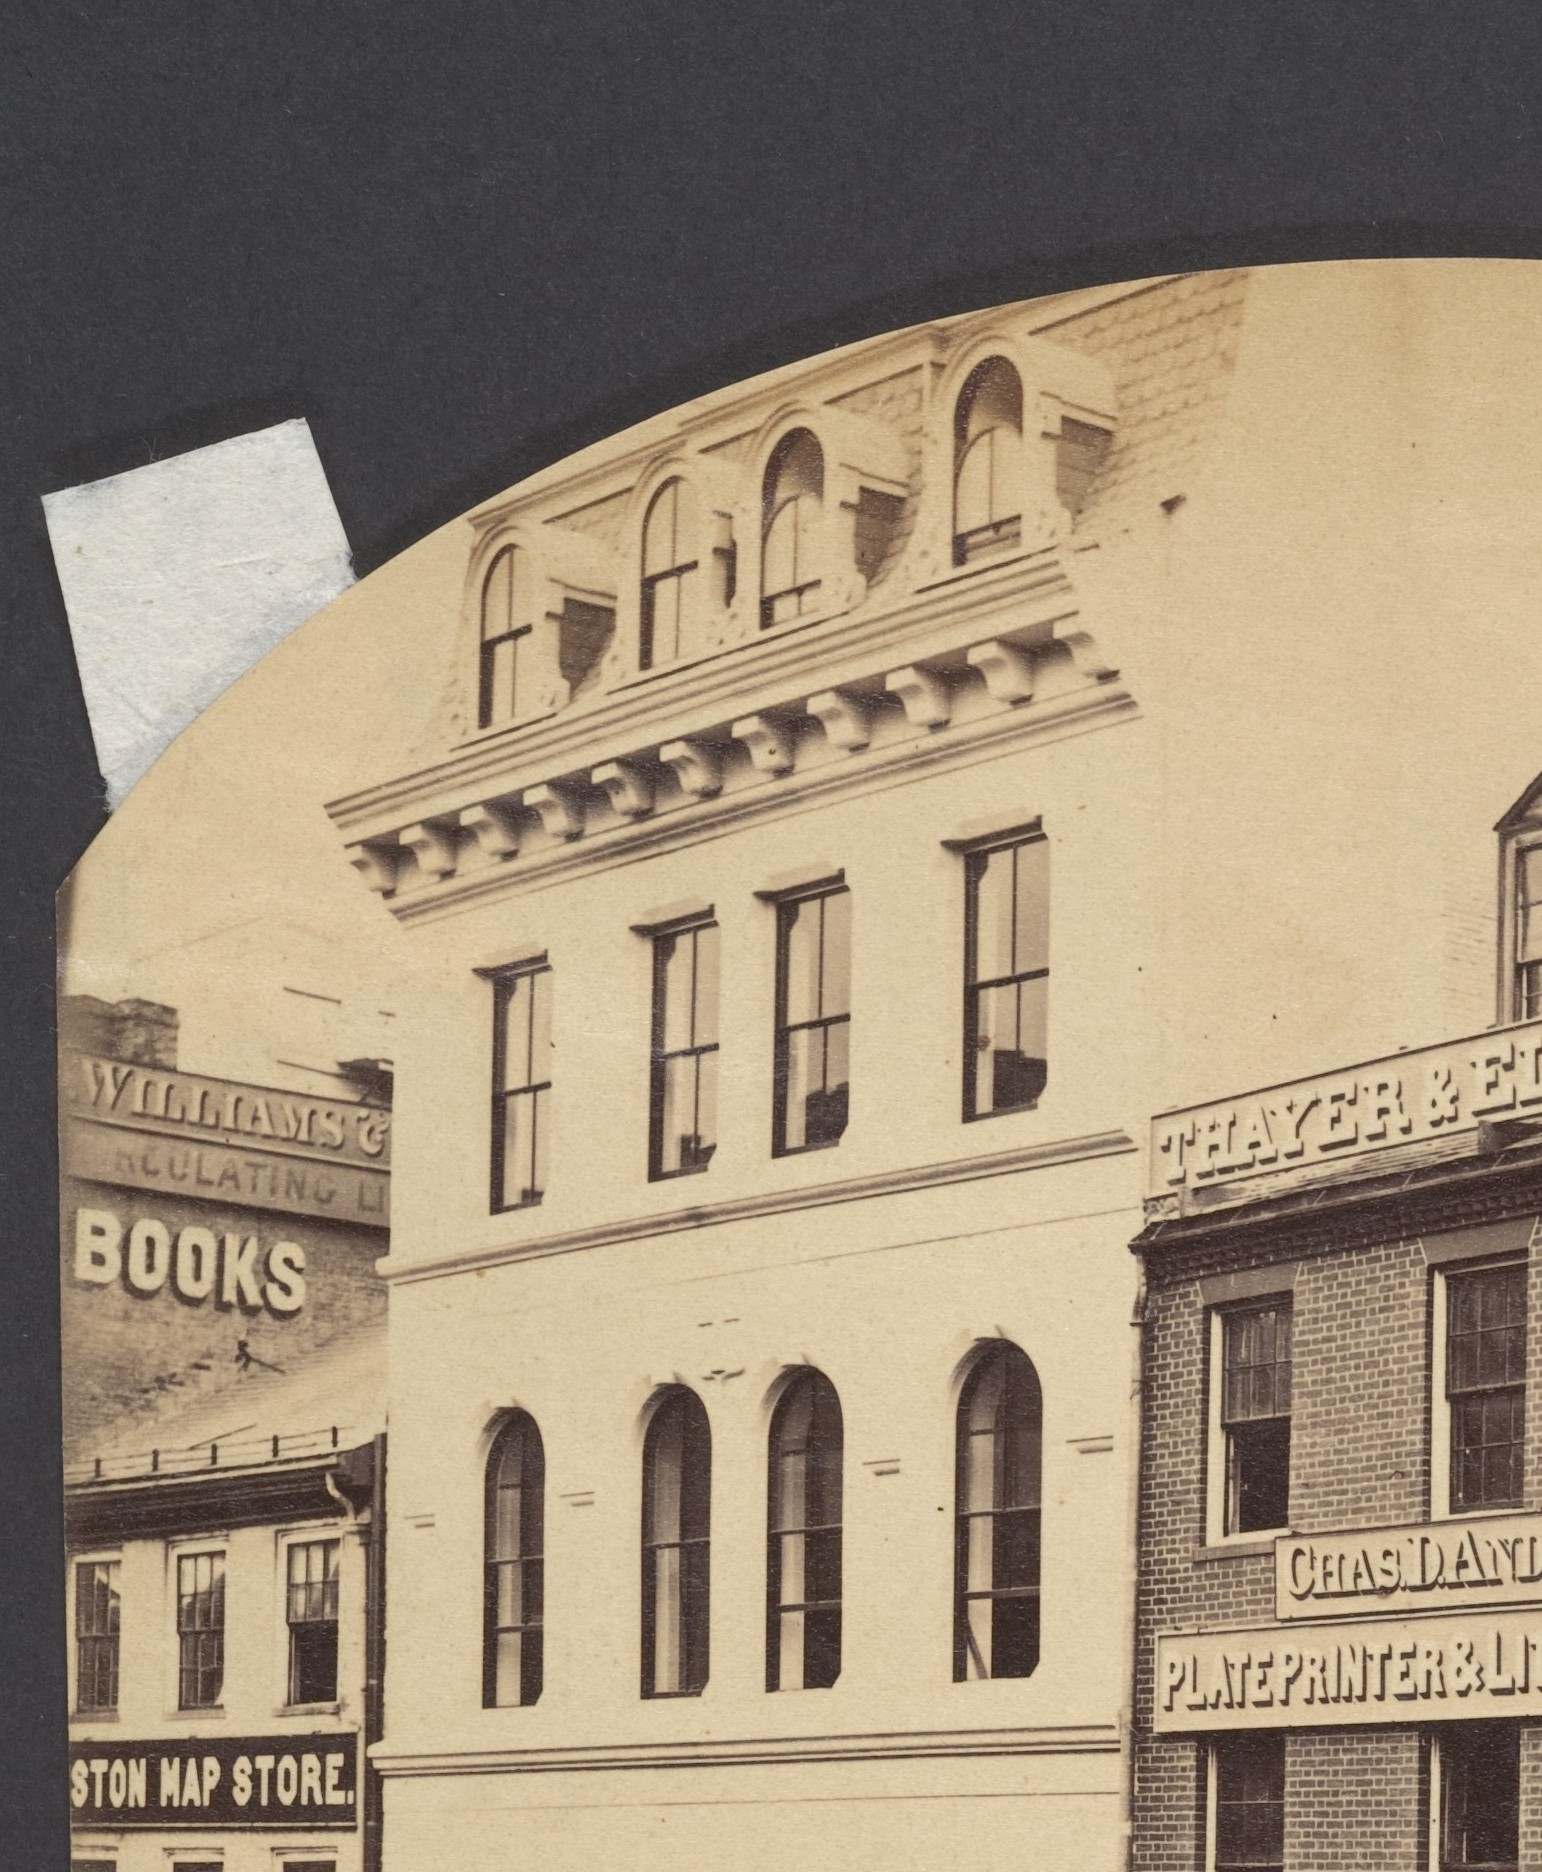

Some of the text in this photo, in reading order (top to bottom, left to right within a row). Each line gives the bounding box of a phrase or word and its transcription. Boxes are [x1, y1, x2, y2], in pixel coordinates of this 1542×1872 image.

[84, 1062, 344, 1150] WILLIAMS
[1161, 1079, 1412, 1184] THAYER
[1422, 1061, 1459, 1126] &
[74, 1207, 307, 1313] BOOKS
[160, 1756, 221, 1808] MAP
[232, 1752, 355, 1807] STORE.
